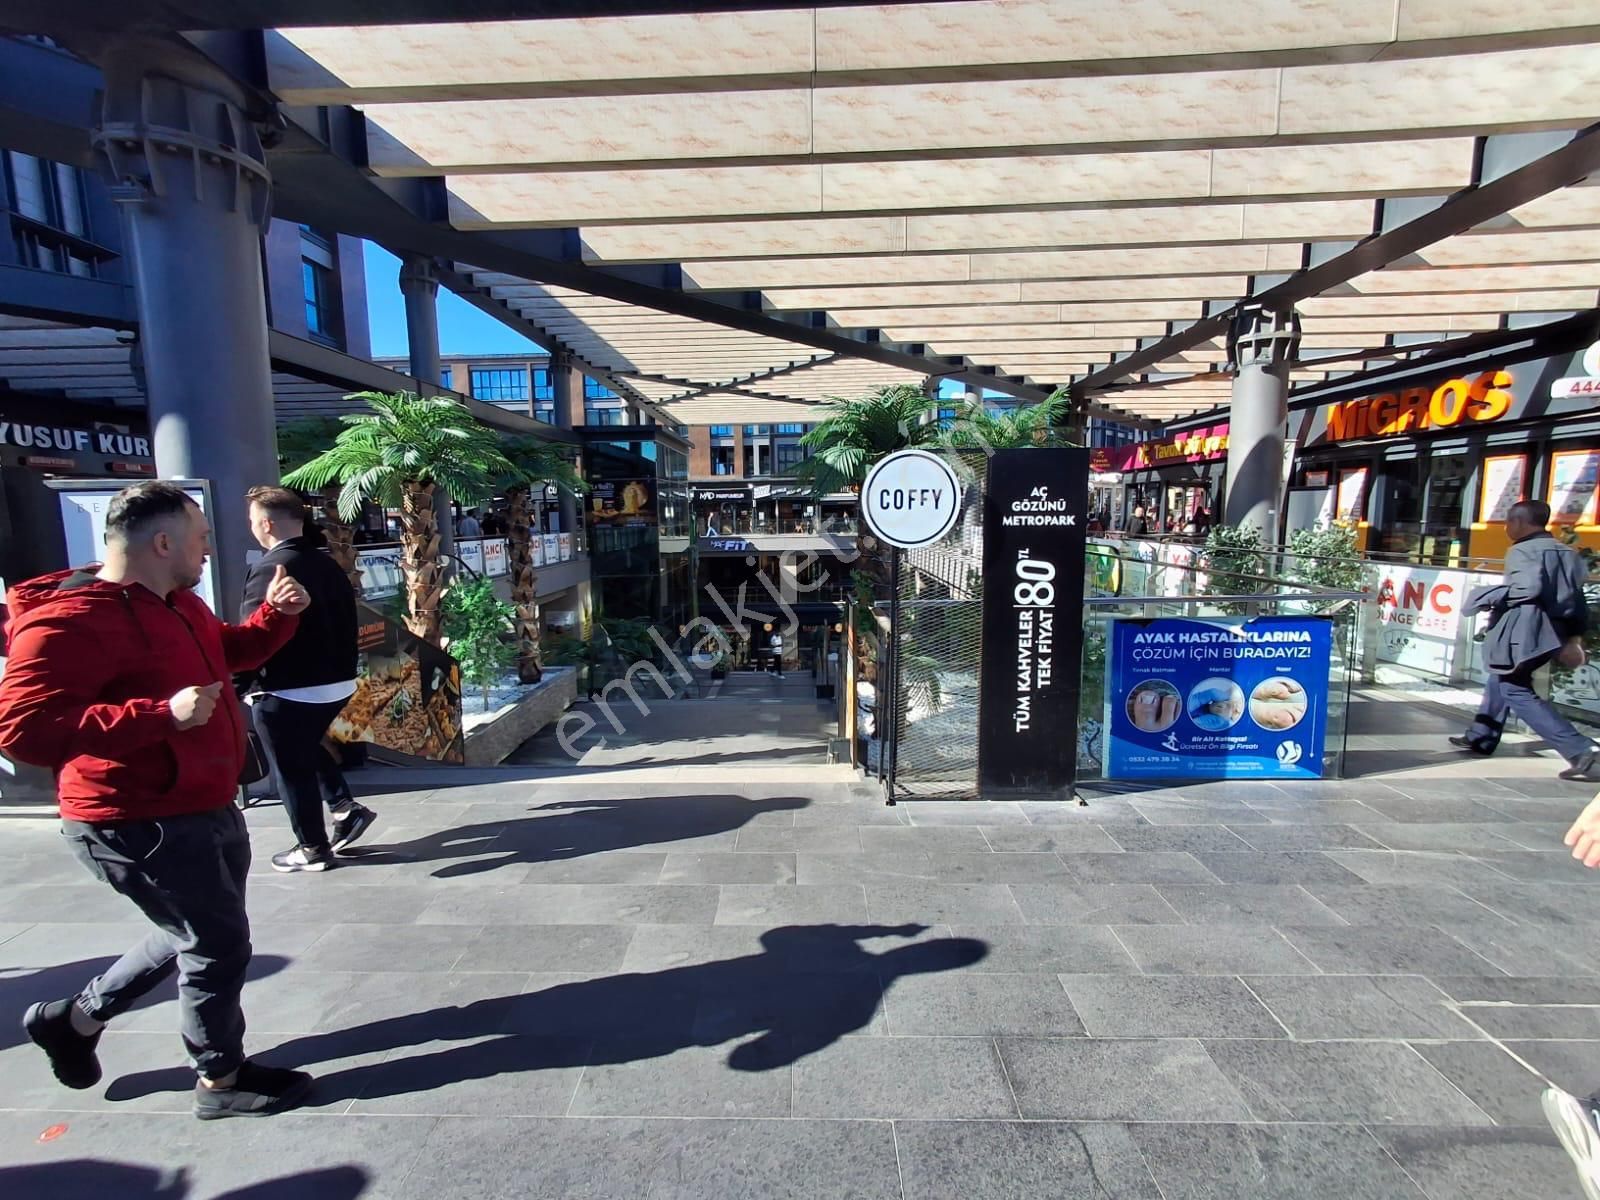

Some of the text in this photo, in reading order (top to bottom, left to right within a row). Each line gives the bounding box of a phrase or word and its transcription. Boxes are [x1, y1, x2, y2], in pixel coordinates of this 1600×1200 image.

[99, 434, 150, 457] KUR
[880, 488, 943, 510] COFFY
[1030, 486, 1048, 500] AÇ
[1011, 498, 1067, 512] GÖZÜNÜ
[1002, 515, 1075, 526] METROPARK
[1014, 548, 1056, 606] 80 TL
[1134, 631, 1311, 644] AYAK HASTALIKLARINA
[1035, 609, 1054, 689] TEK FİYAT
[1132, 645, 1311, 662] ÇÖZÜM İÇİN BURADAYIZ!
[1013, 610, 1034, 733] TÜM KAHVELER
[1180, 742, 1208, 750] Ücretsiz
[1208, 742, 1219, 750] Ön
[1220, 743, 1236, 751] Bilgi
